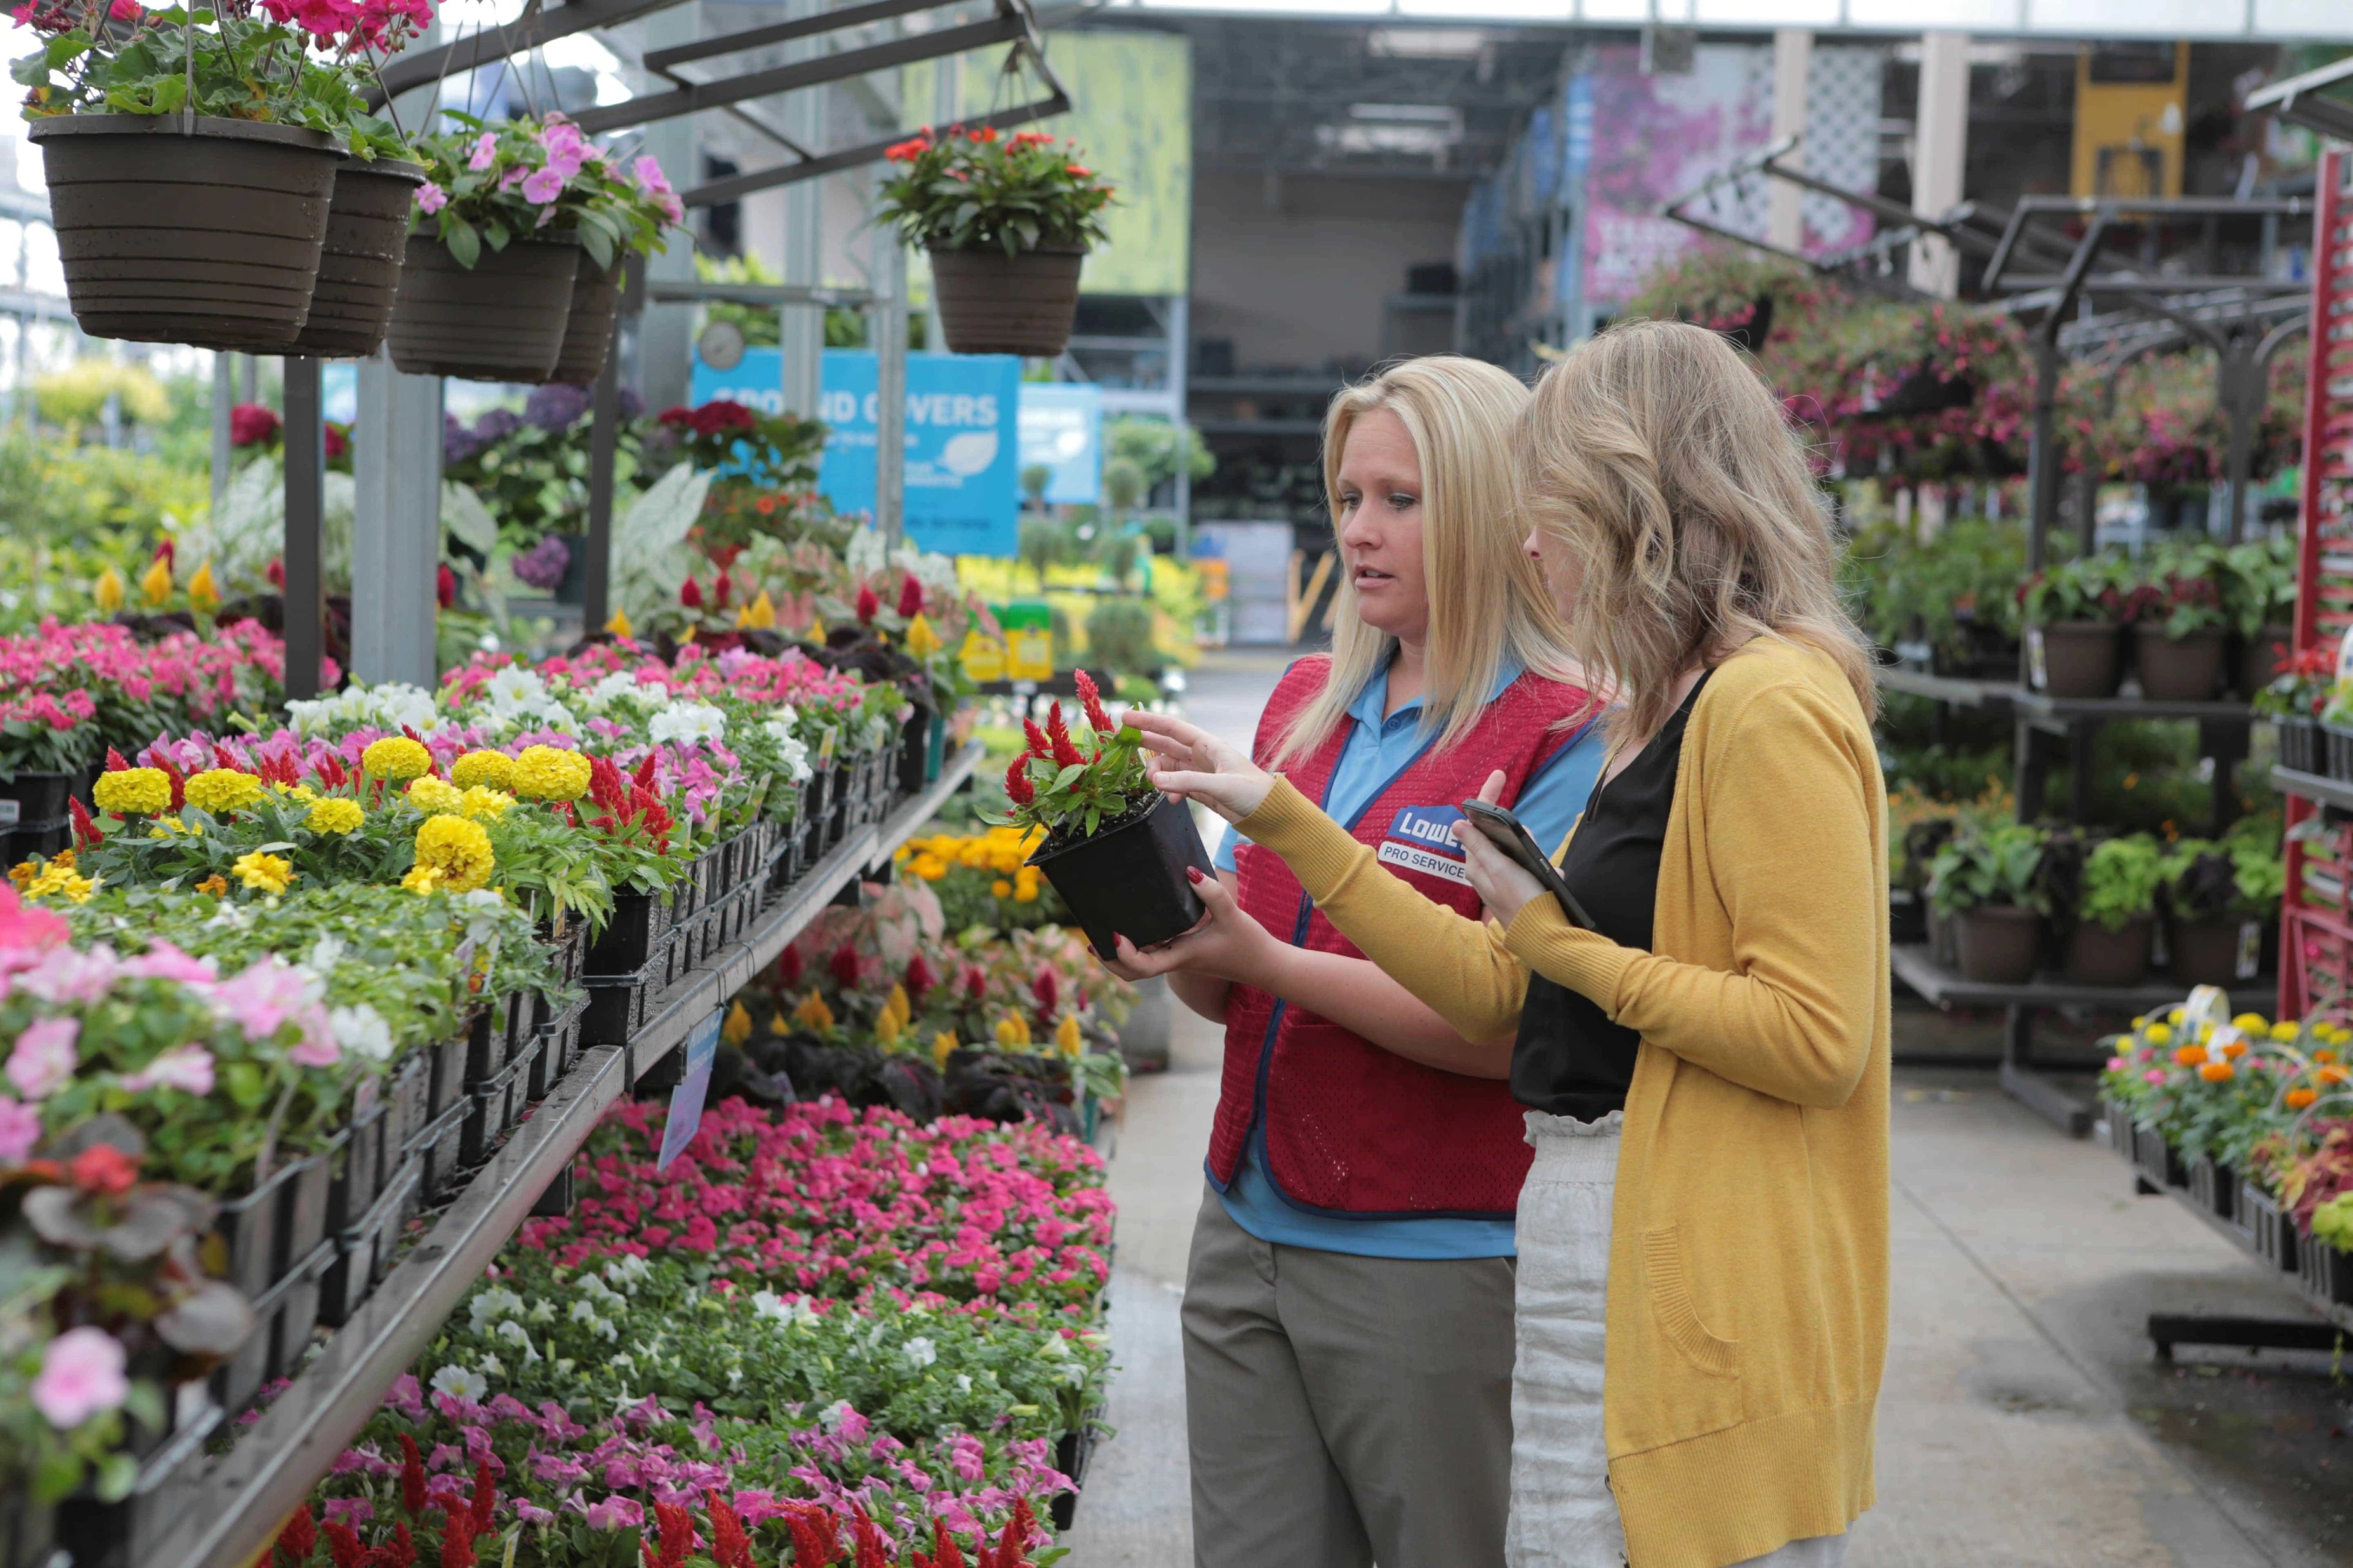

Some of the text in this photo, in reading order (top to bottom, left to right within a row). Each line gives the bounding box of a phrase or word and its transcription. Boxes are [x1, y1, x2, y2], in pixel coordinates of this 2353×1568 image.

[863, 392, 999, 426] CVERS
[1399, 812, 1467, 852] LOWE
[1384, 846, 1409, 861] PRO
